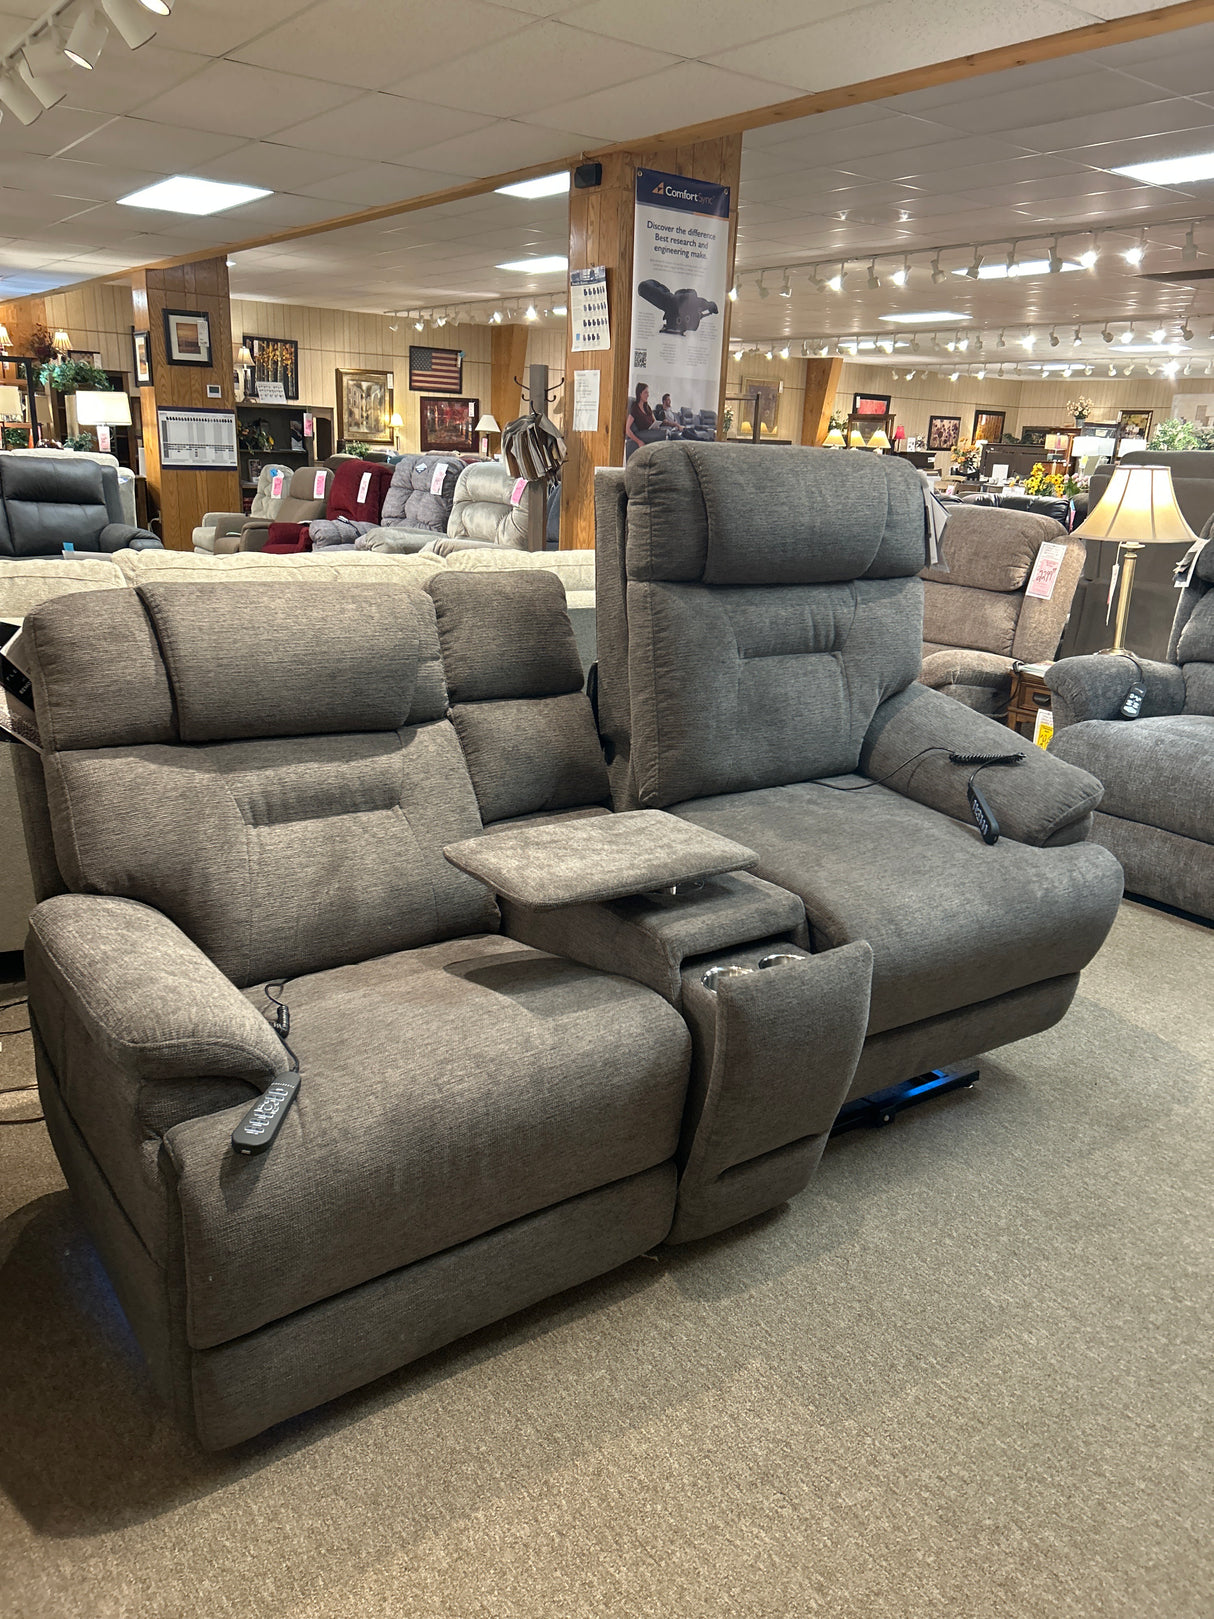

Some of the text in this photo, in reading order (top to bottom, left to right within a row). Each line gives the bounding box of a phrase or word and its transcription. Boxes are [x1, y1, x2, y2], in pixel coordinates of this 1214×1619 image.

[647, 220, 716, 240] Discover the difference
[655, 232, 709, 250] Best research and
[654, 245, 689, 259] engineering
